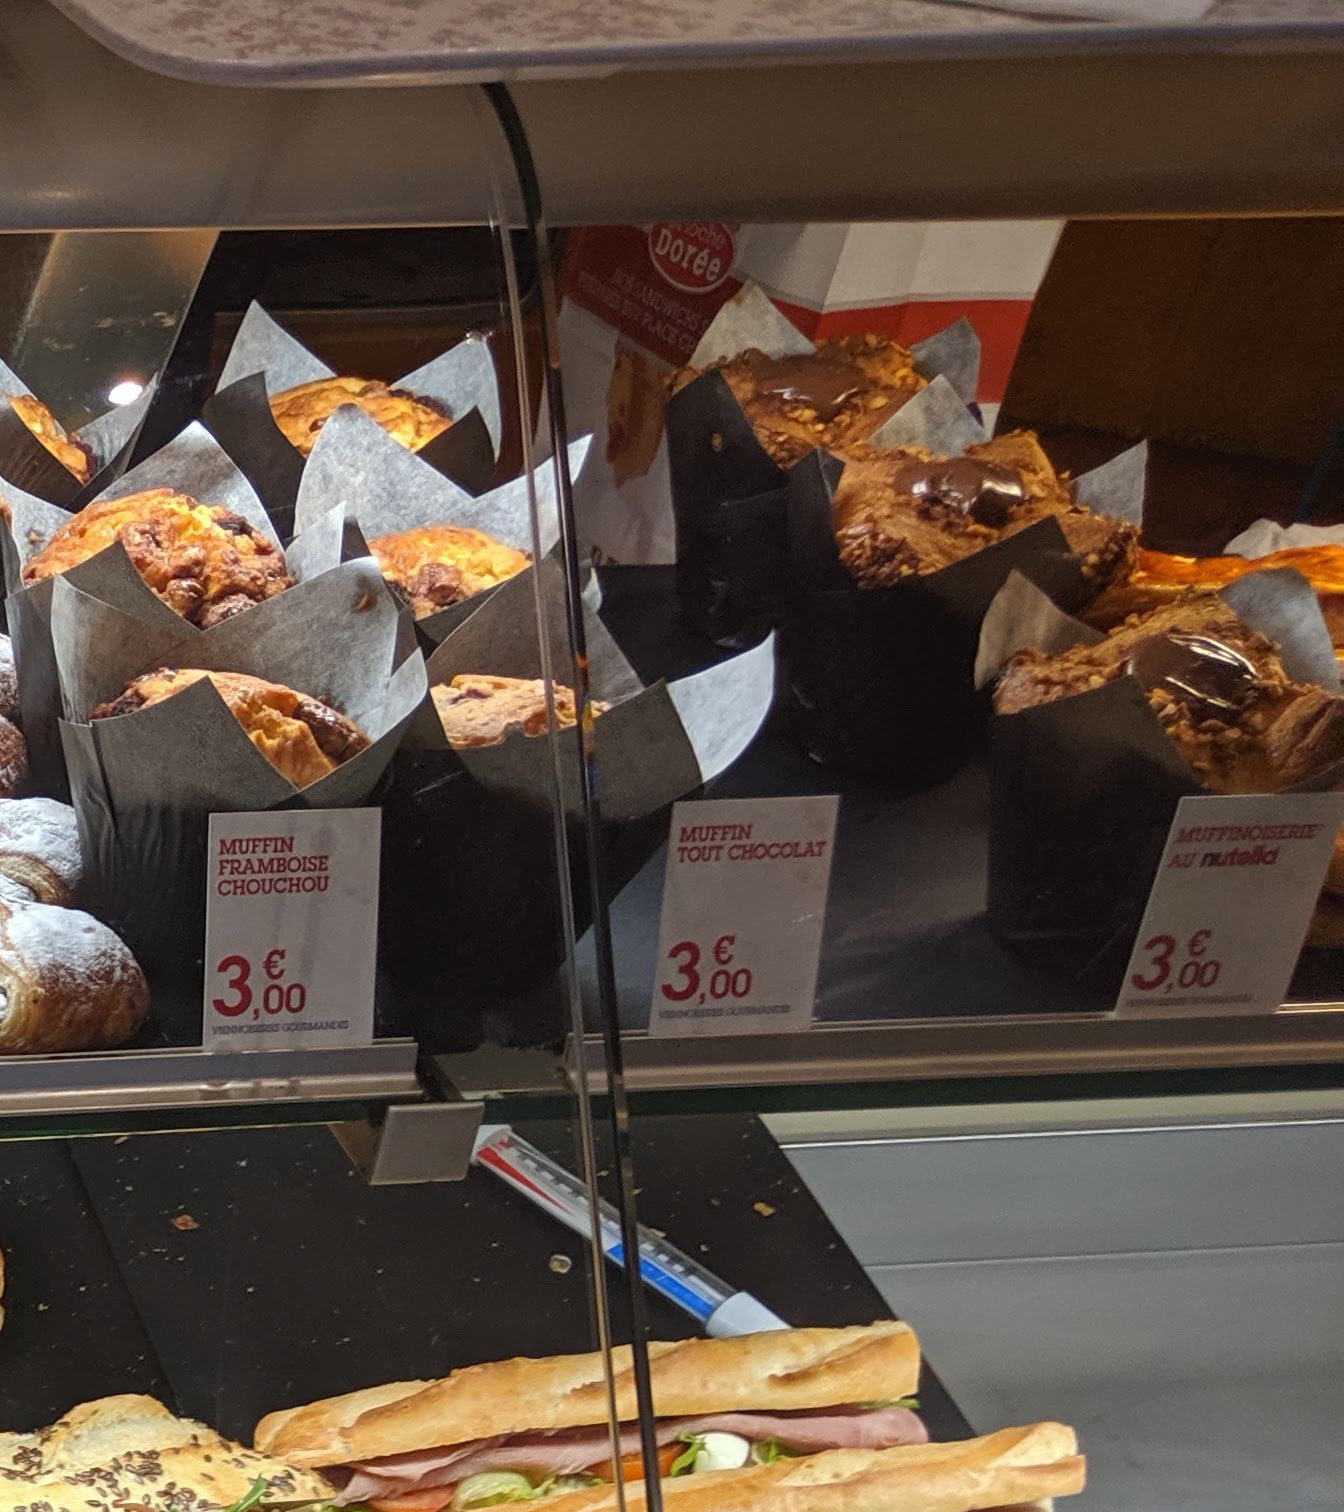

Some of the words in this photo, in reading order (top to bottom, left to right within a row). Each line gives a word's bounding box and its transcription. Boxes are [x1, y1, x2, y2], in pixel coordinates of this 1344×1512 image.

[655, 229, 721, 281] Dorée
[680, 823, 753, 843] MUFFIN
[219, 836, 294, 855] MUFFIN
[678, 845, 725, 863] TOUT
[728, 840, 826, 861] CHOCOLAT
[218, 855, 329, 876] FRAMBOISE
[1167, 852, 1197, 869] AU
[1200, 846, 1279, 867] nutella
[217, 876, 329, 896] CHOUCHOU
